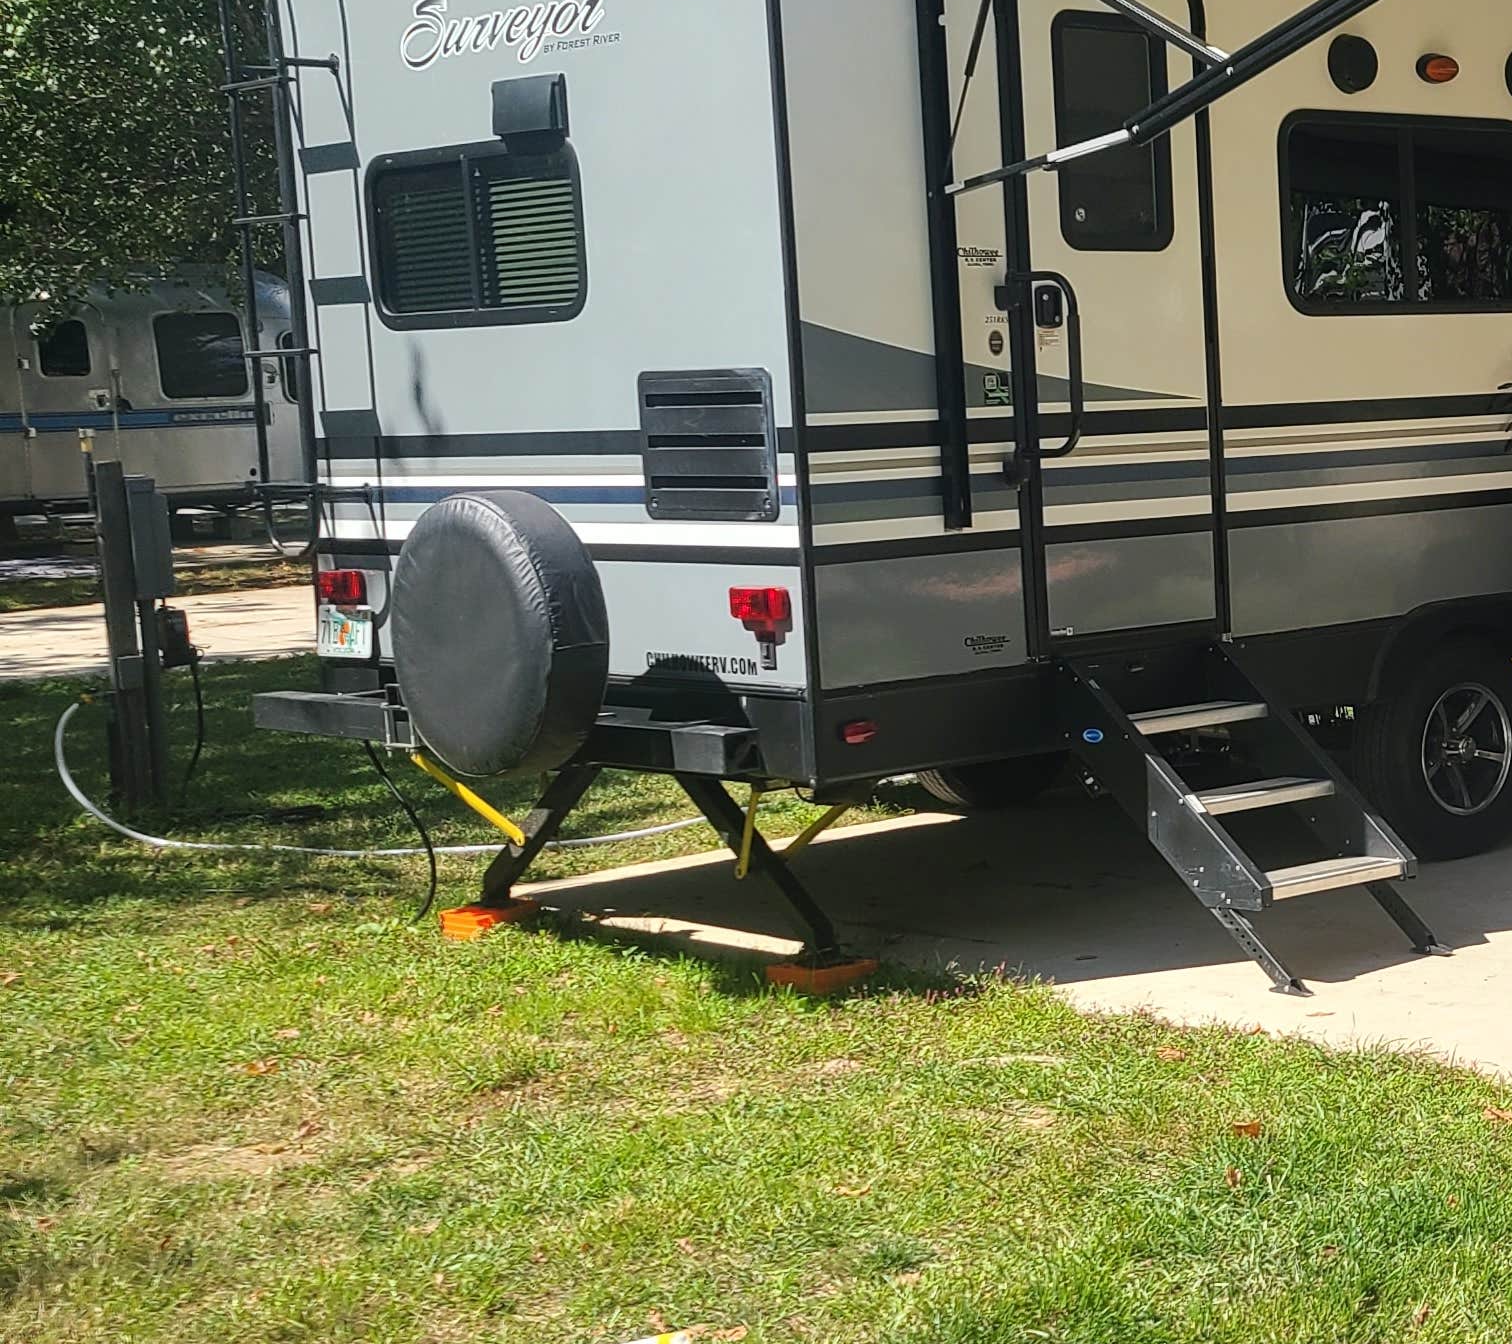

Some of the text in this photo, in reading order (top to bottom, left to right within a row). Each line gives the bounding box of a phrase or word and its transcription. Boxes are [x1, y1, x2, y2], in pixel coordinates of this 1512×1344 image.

[543, 33, 620, 54] BY FOREST RIVER
